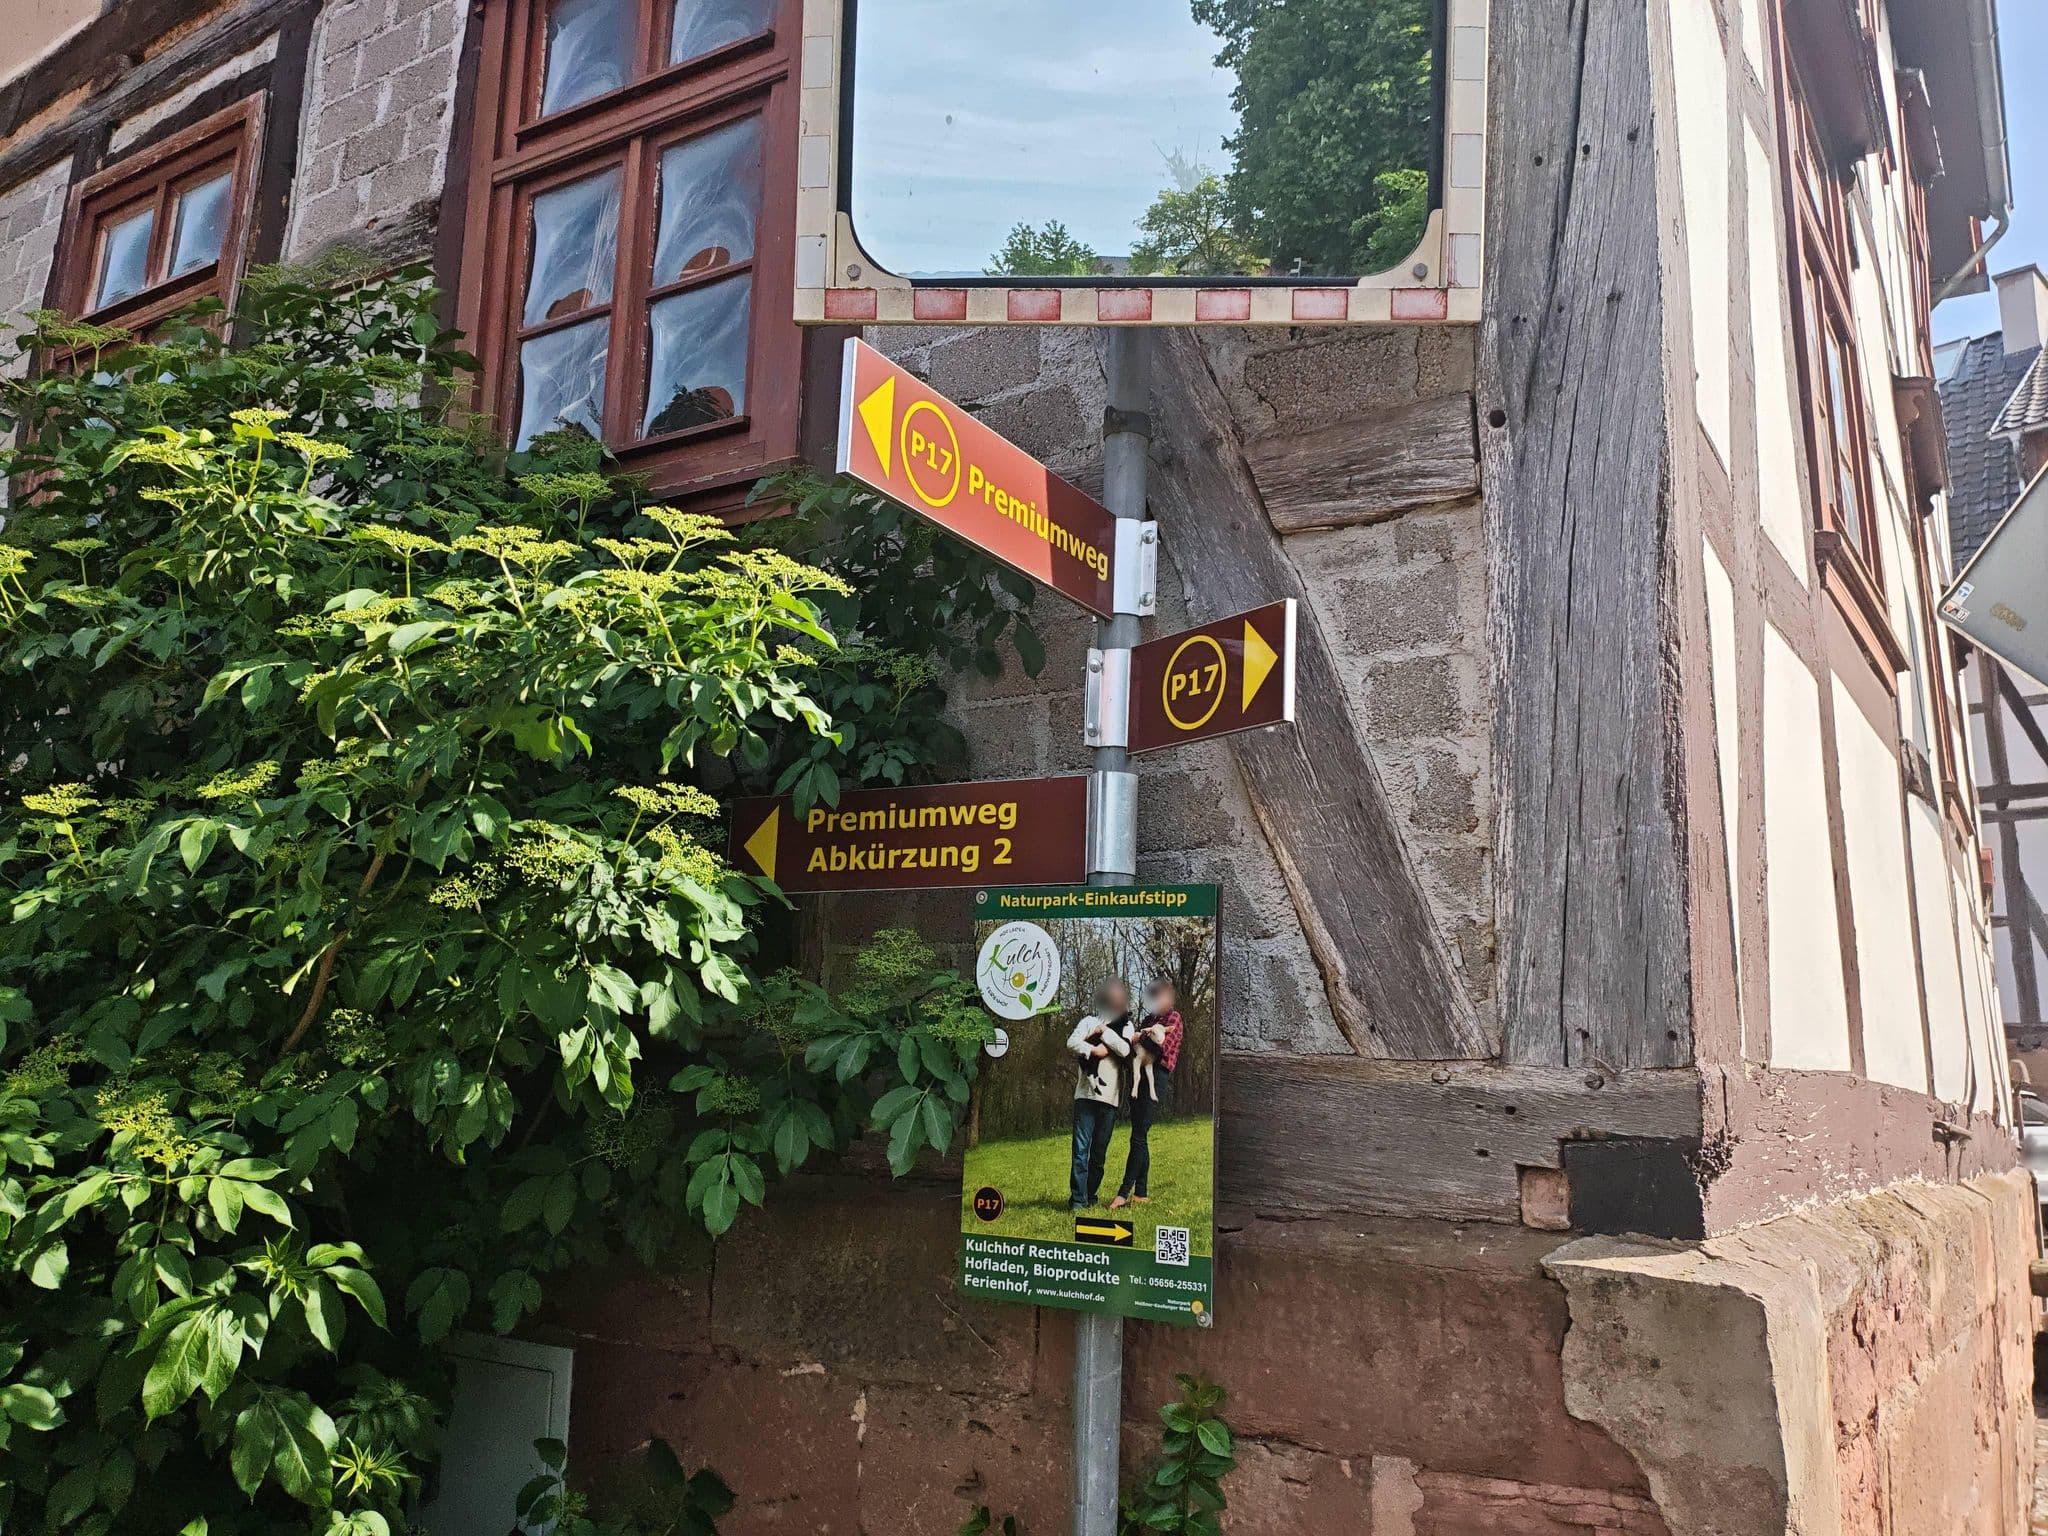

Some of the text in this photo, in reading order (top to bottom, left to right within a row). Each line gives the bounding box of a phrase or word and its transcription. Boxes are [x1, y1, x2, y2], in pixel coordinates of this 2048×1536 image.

[911, 430, 1109, 581] P17 Premiumweg
[1171, 664, 1219, 701] P17
[807, 801, 1018, 834] Premiumweg
[807, 838, 1013, 872] Abkürzung 2
[1000, 890, 1187, 909] Naturpark-Einkaufstipp
[980, 938, 1041, 977] Kulch
[977, 1198, 999, 1210] P17
[966, 1238, 1110, 1265] Kulchhof Rechtebach
[965, 1256, 1120, 1285] Hofladen, Bioprodukte
[1129, 1274, 1207, 1293] Tel.: 05656-255331
[964, 1274, 1105, 1302] Ferienhof, www.kulchhof.de
